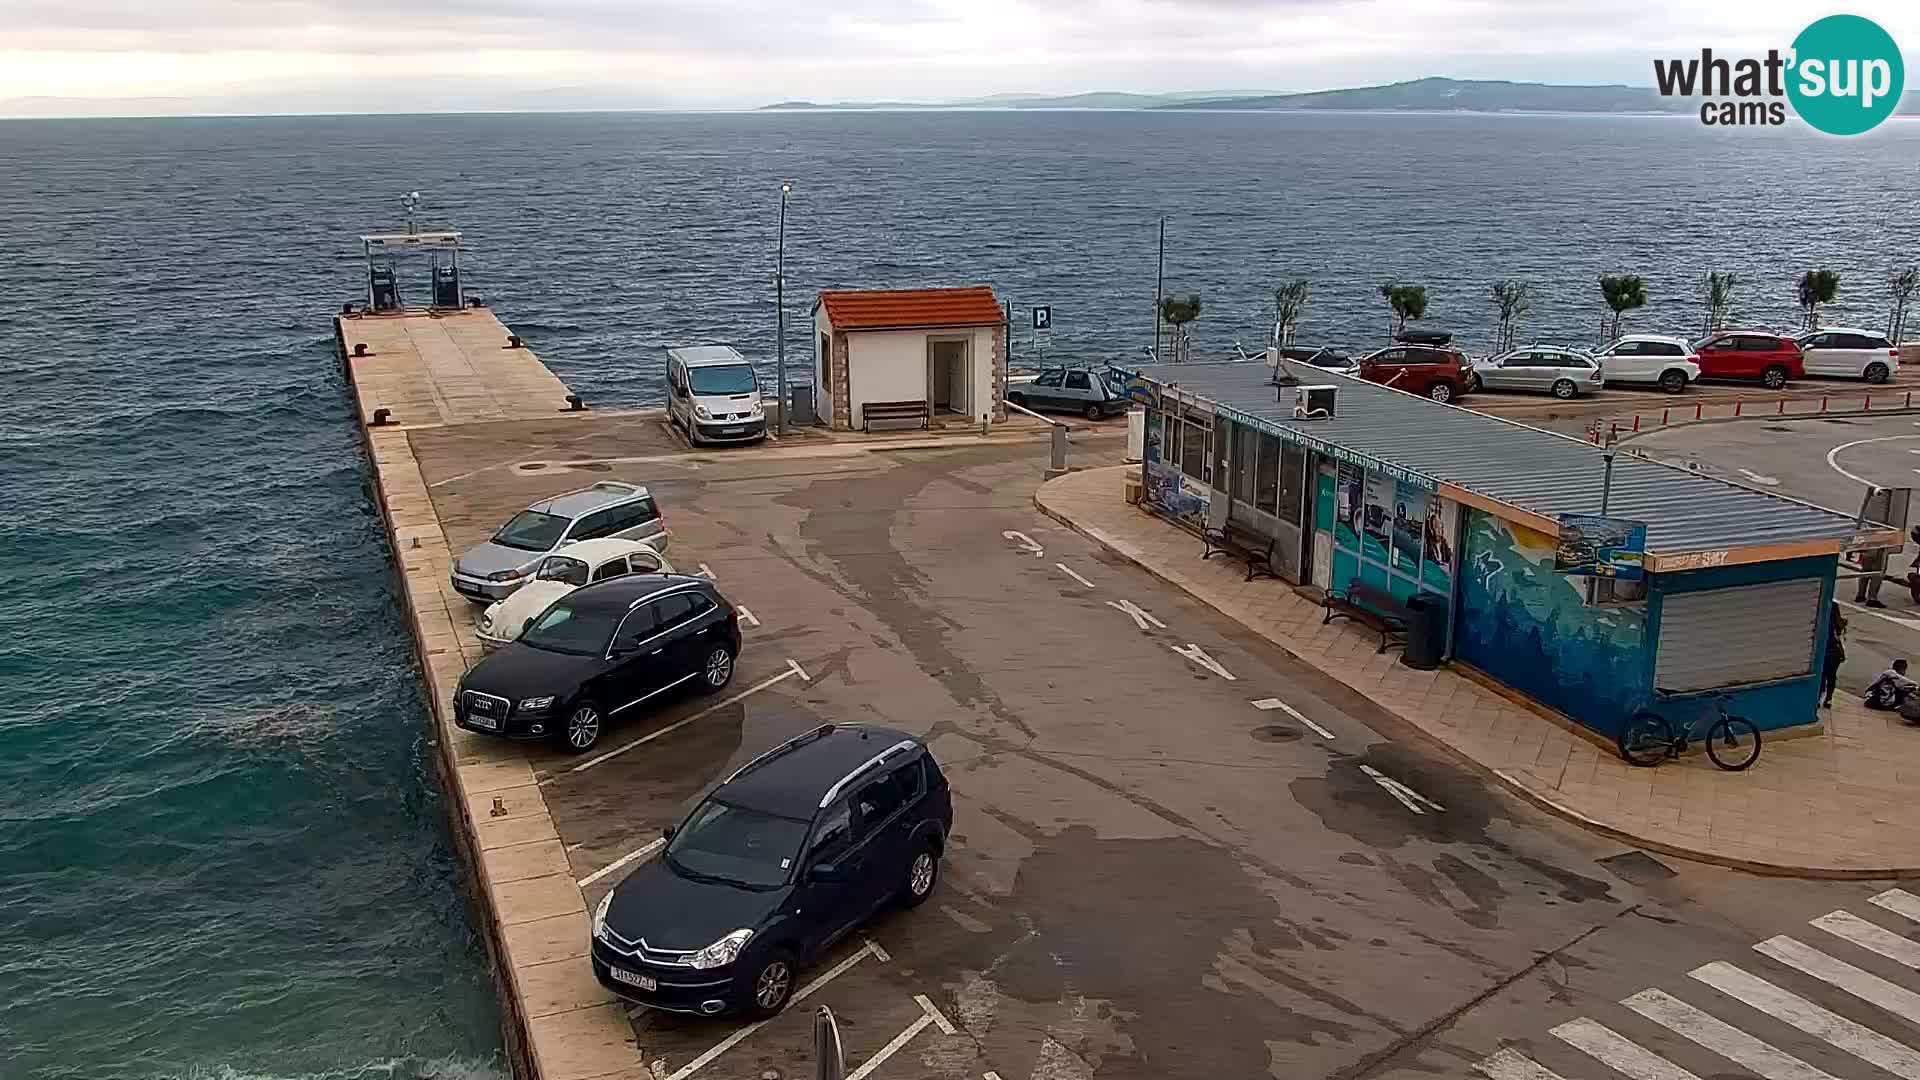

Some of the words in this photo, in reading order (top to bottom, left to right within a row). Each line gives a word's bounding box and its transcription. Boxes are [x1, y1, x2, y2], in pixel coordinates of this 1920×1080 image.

[1037, 309, 1047, 326] P
[1334, 447, 1348, 461] BUS
[1348, 452, 1379, 473] STATION
[1381, 463, 1406, 481] TICKET
[1407, 473, 1433, 490] OFFICE
